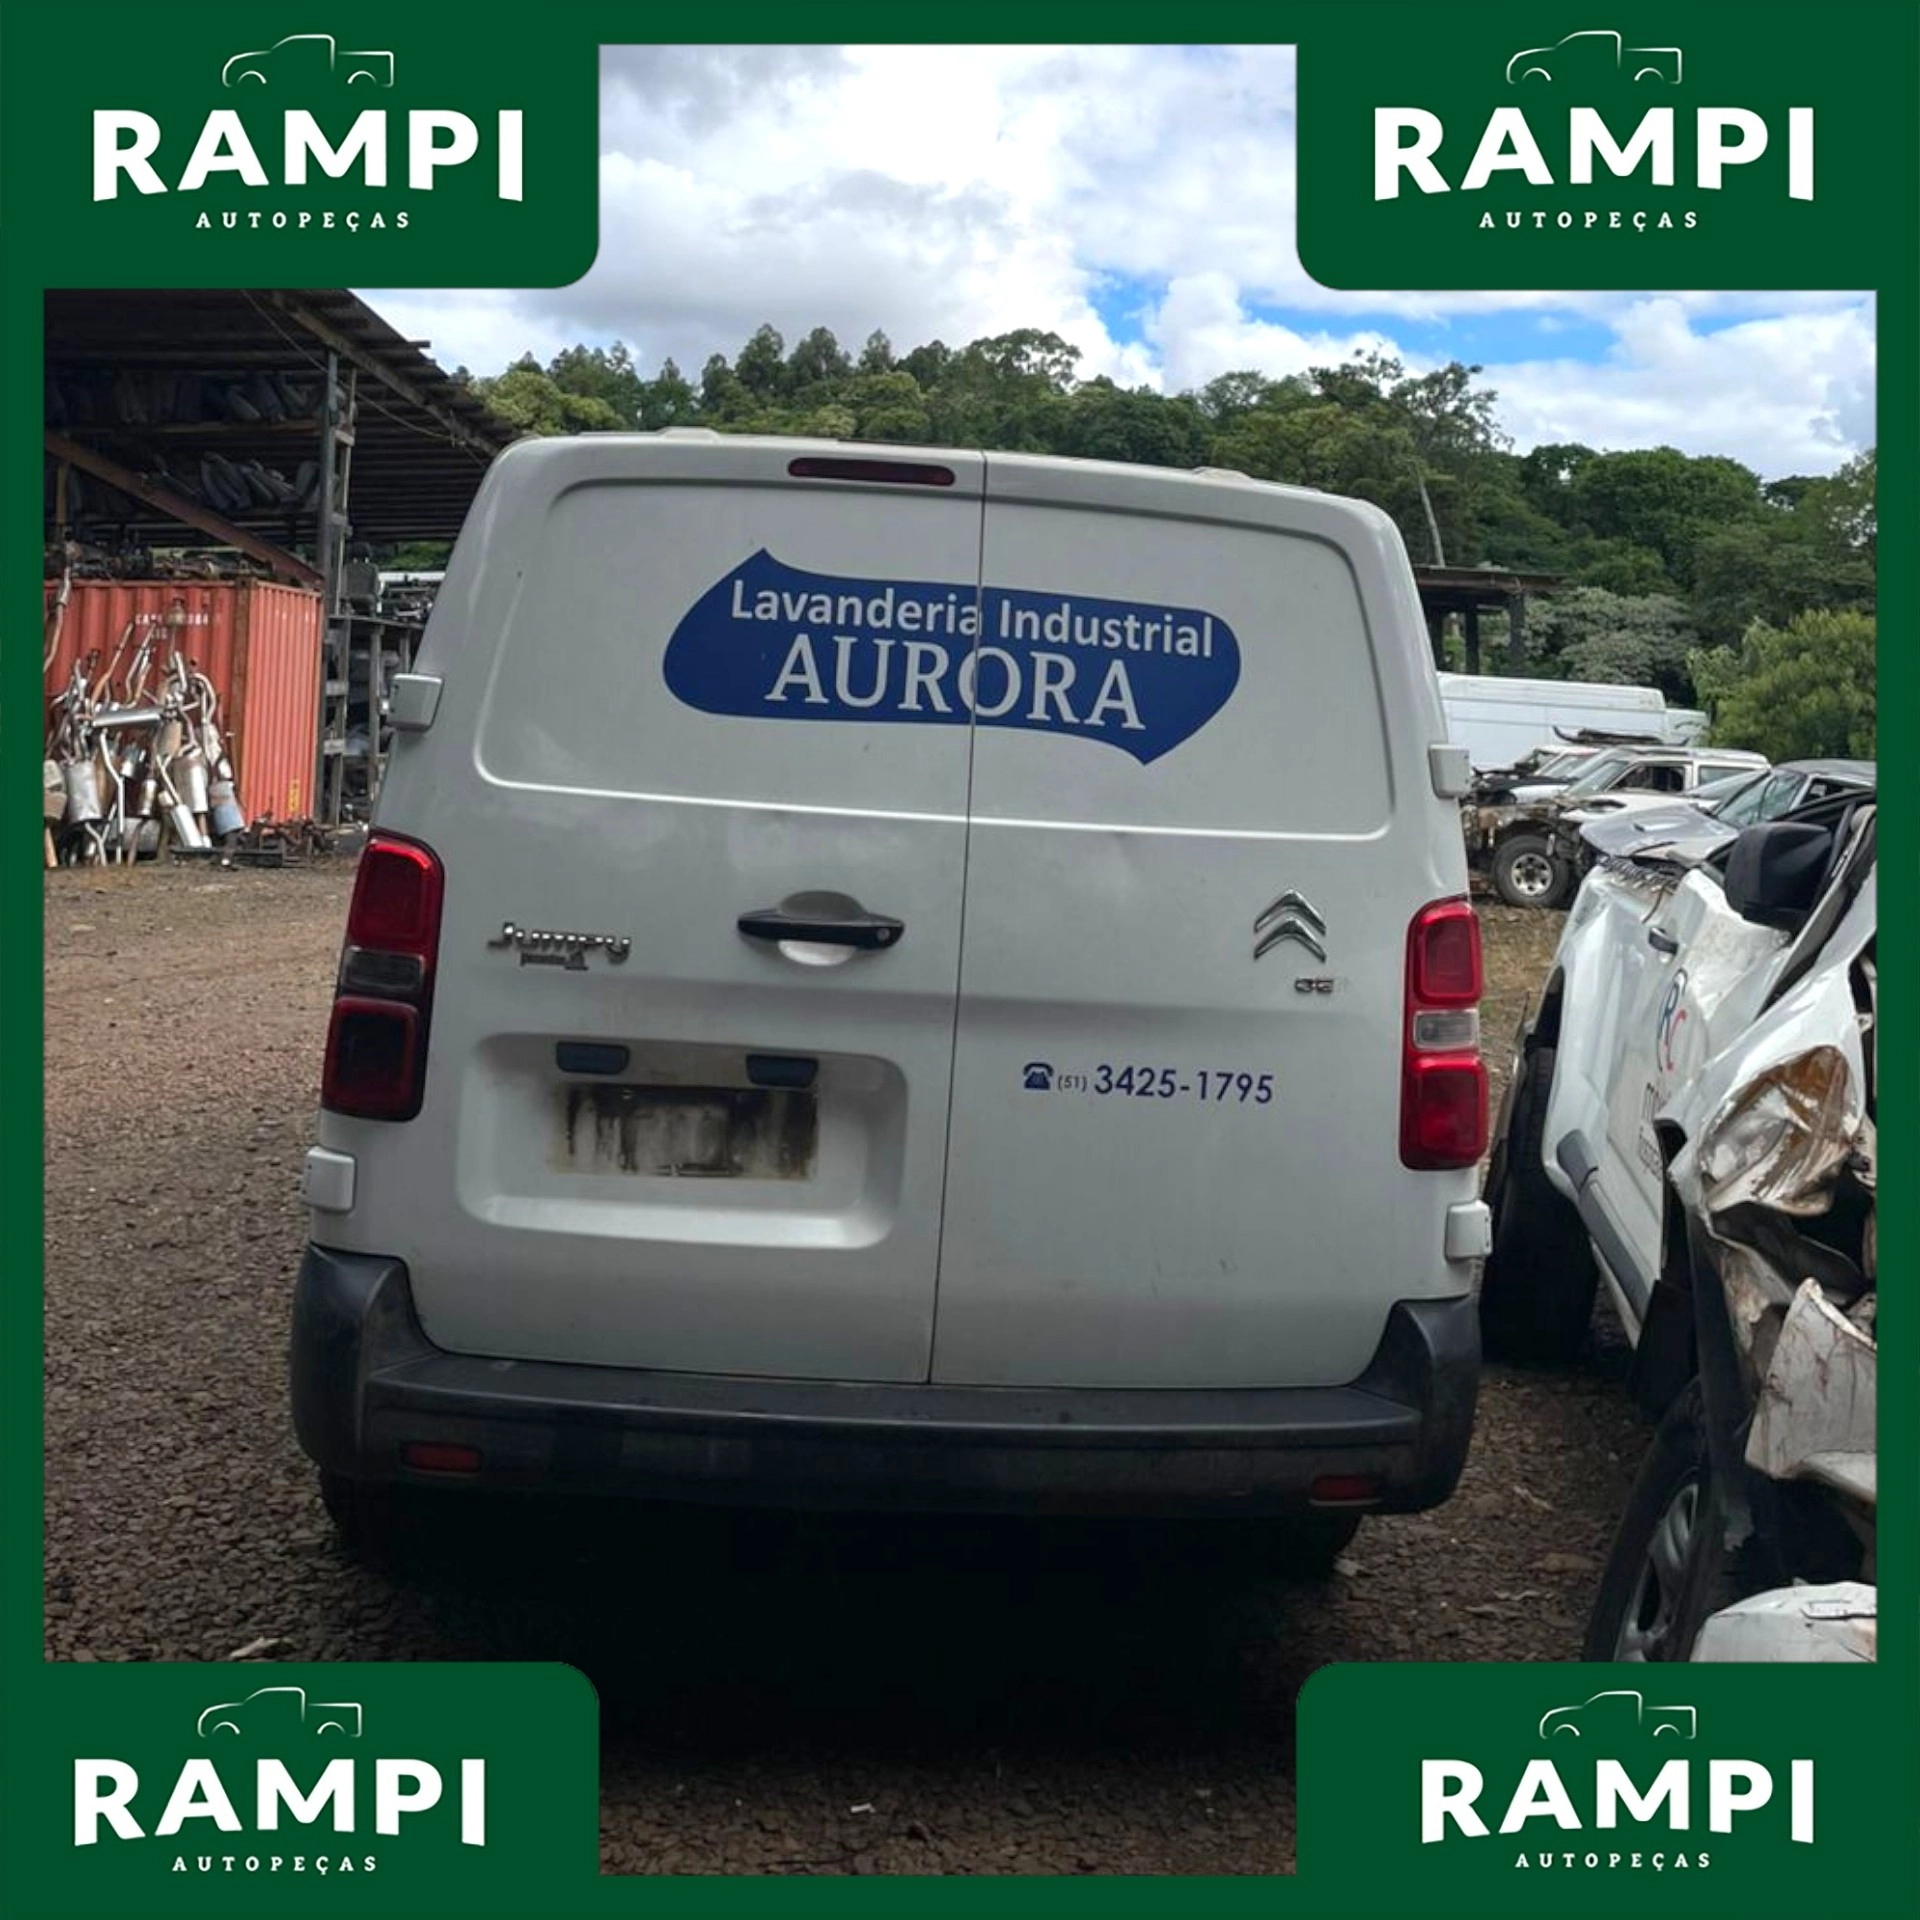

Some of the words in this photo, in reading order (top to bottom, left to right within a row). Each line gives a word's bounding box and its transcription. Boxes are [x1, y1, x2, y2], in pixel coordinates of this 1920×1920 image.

[731, 579, 982, 636] Lavanderia
[999, 599, 1213, 658] Industrial
[764, 633, 1146, 730] AURORA
[1058, 1074, 1088, 1093] (51)
[1095, 1065, 1274, 1104] 3425-1795
